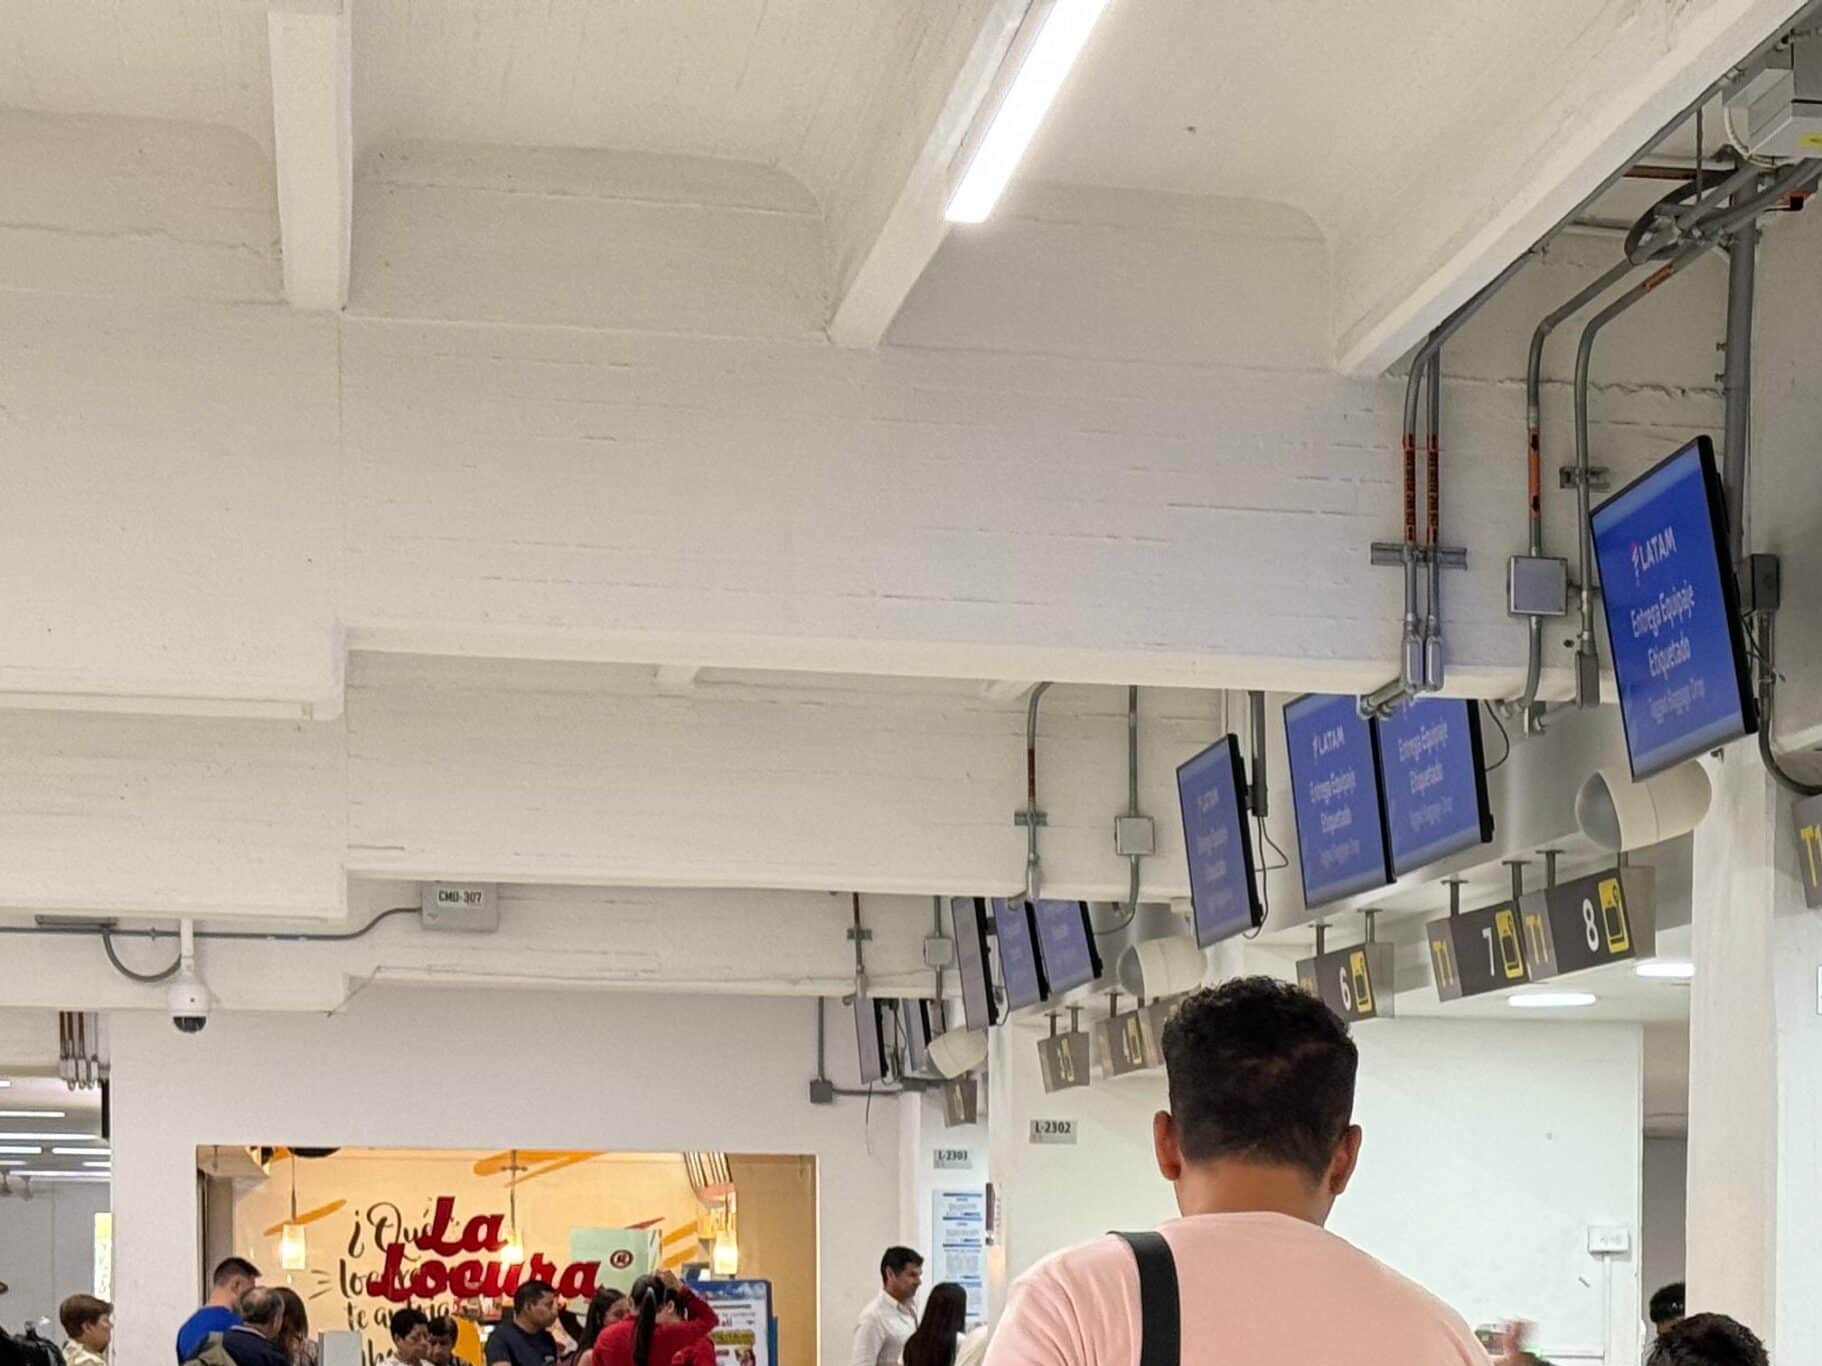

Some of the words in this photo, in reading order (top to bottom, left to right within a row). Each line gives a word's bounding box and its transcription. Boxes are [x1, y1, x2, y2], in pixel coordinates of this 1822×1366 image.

[1639, 525, 1677, 572] LATAM
[1581, 897, 1600, 953] 8
[1339, 966, 1351, 1011] 6
[415, 1196, 509, 1257] La
[366, 1242, 602, 1303] Locura
